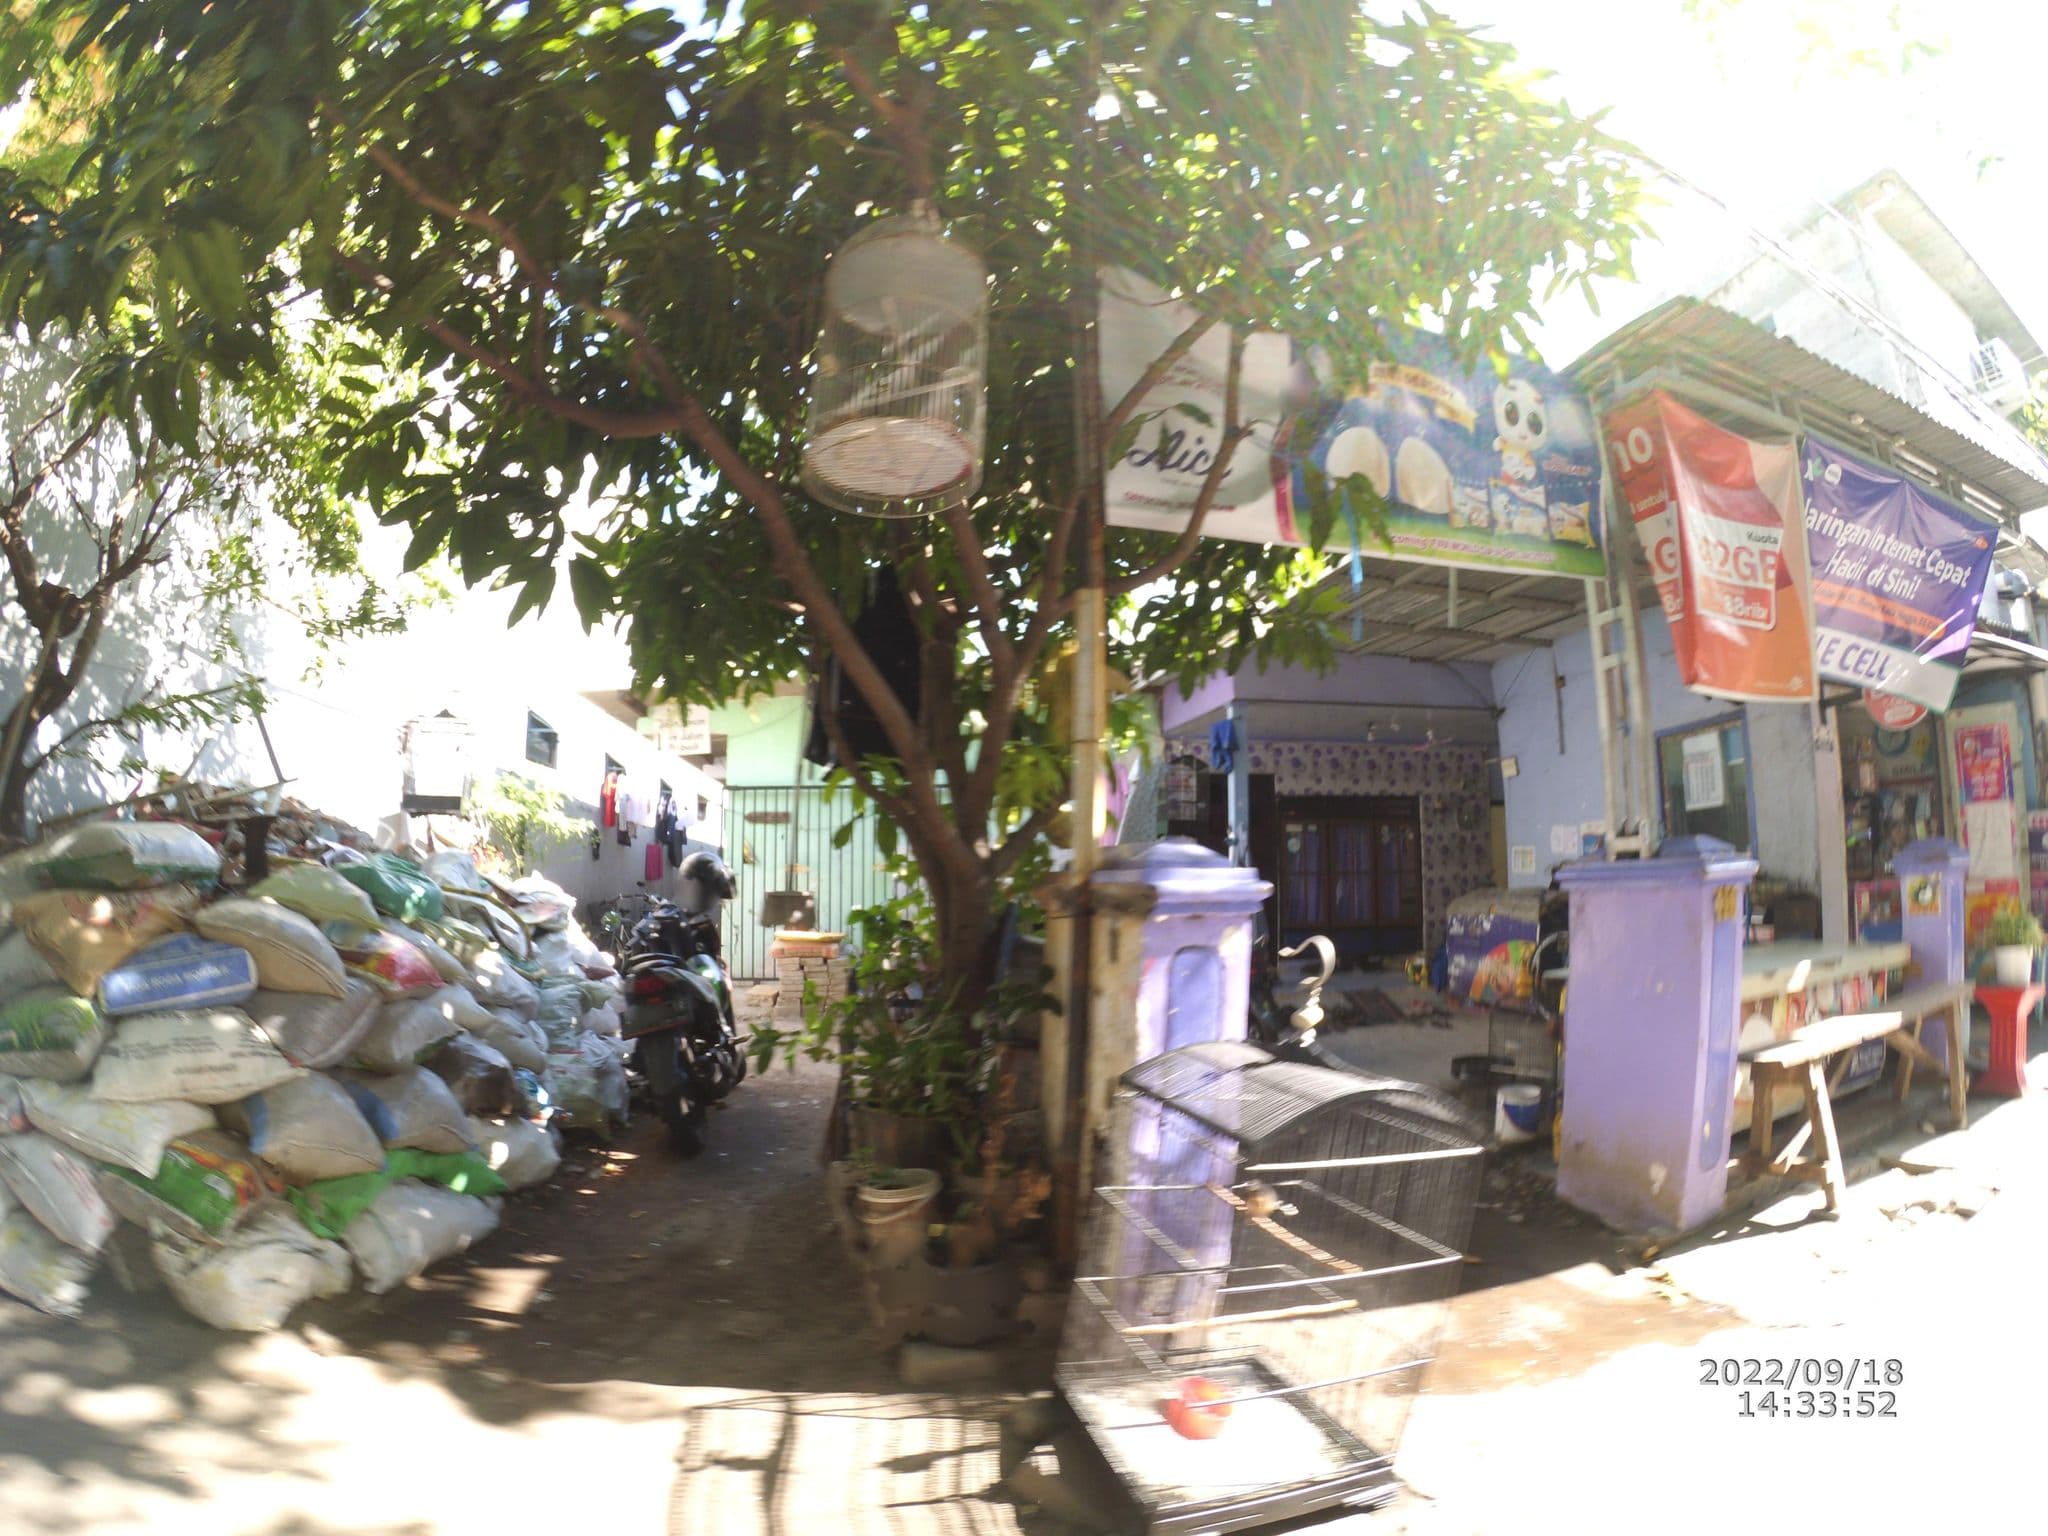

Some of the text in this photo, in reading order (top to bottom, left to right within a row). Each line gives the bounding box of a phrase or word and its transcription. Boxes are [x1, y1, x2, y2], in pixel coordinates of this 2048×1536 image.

[1824, 550, 1922, 600] Hadir di Sini!
[1869, 526, 1926, 568] Internet
[1925, 548, 1972, 587] Cepat
[1839, 642, 1891, 682] CELL
